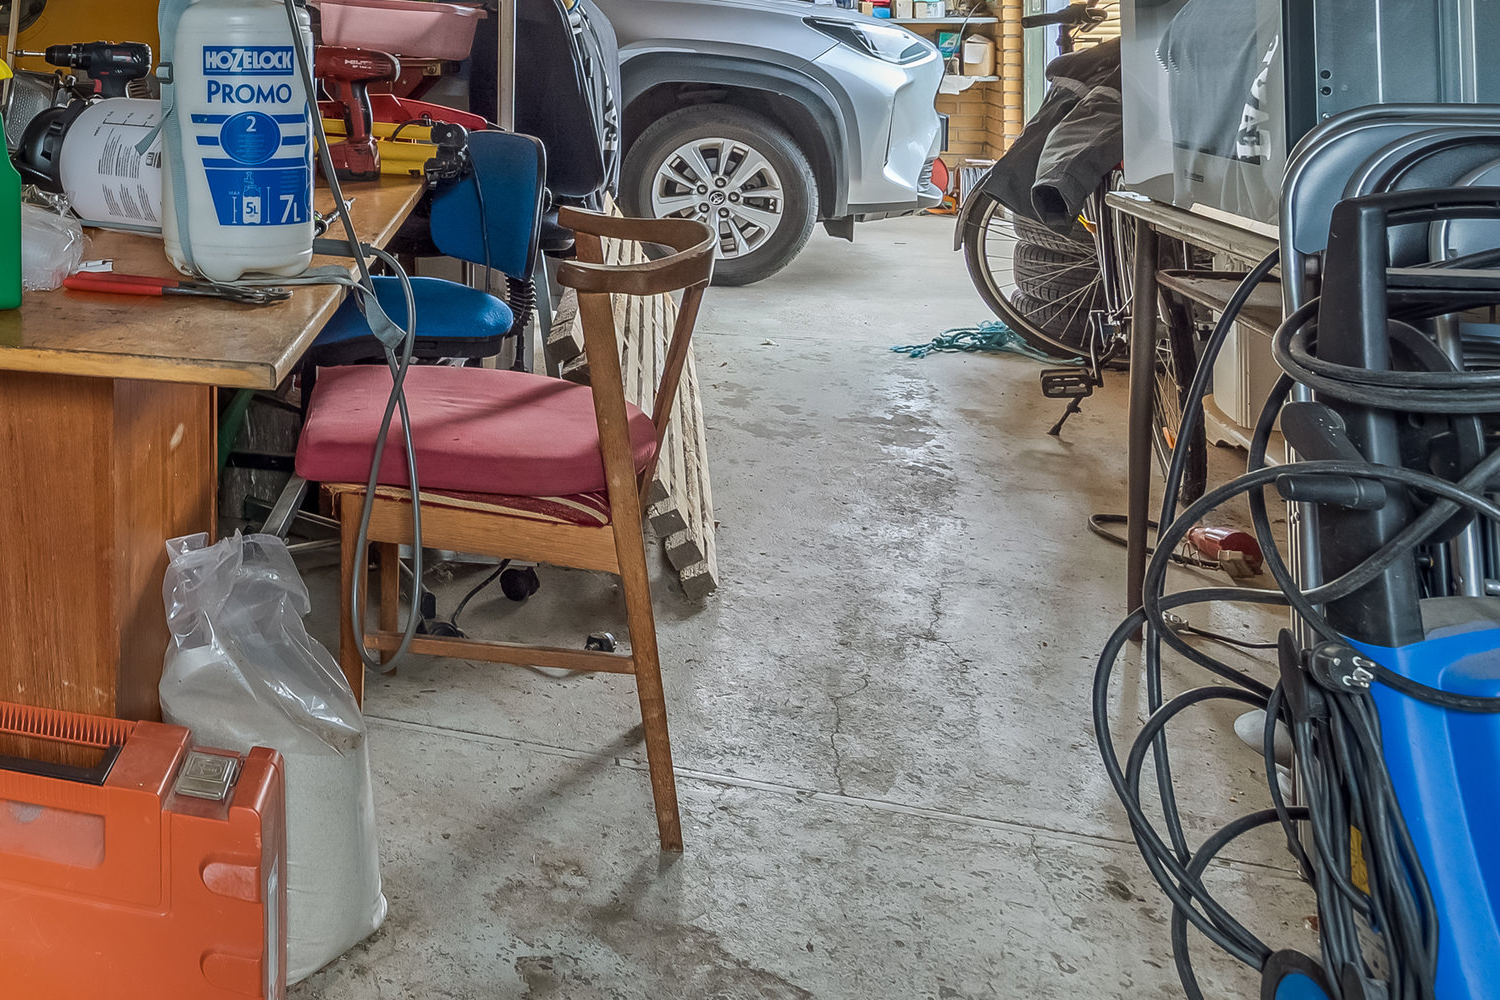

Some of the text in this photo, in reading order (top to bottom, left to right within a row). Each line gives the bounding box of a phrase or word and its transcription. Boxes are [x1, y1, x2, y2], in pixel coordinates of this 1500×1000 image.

[205, 48, 293, 73] HOZELOCK
[207, 80, 292, 104] PROMO
[245, 116, 257, 132] 2
[245, 202, 258, 215] 5L
[279, 194, 301, 224] 7L
